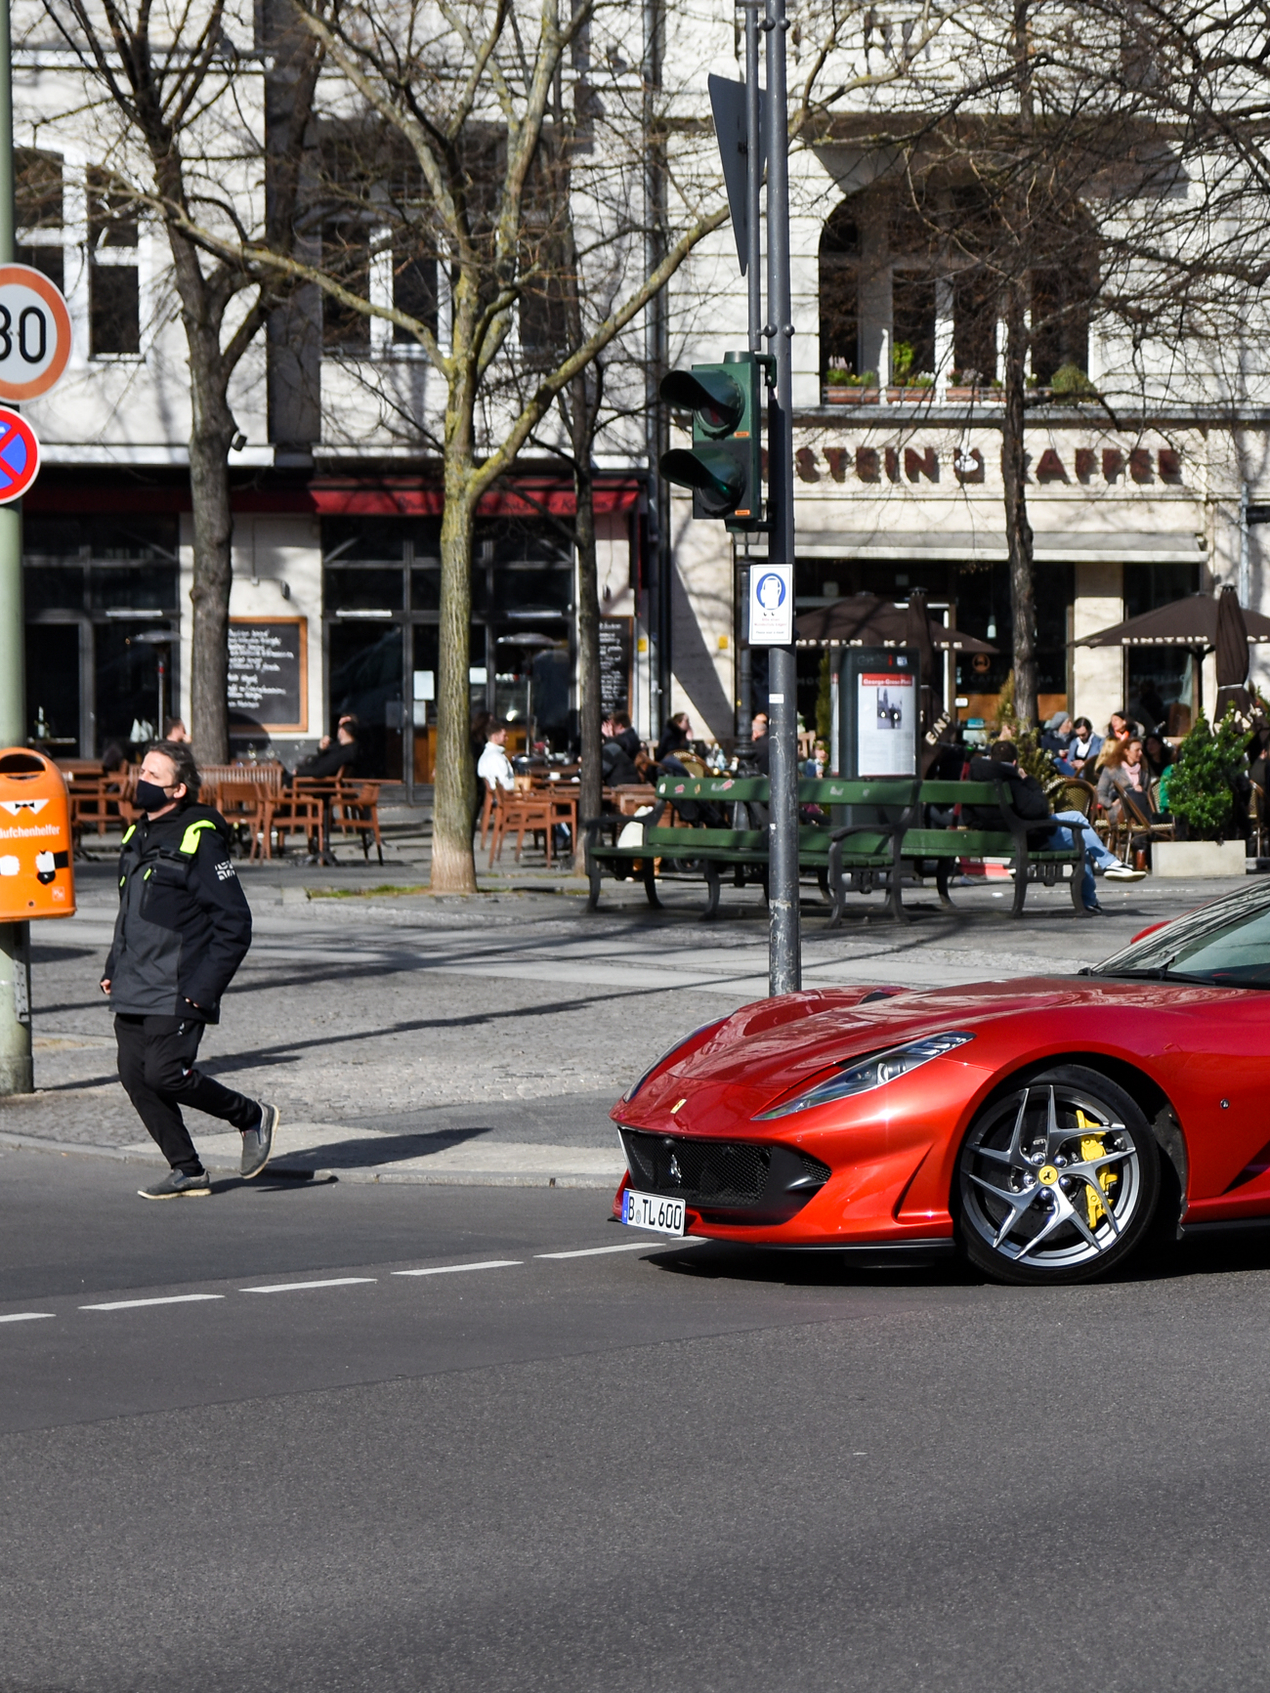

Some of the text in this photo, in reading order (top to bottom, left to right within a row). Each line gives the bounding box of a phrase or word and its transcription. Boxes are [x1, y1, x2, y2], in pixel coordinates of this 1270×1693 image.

[1001, 447, 1183, 485] AFFEE
[1122, 636, 1209, 645] EINSTEIN
[628, 1196, 682, 1230] B TL 600
